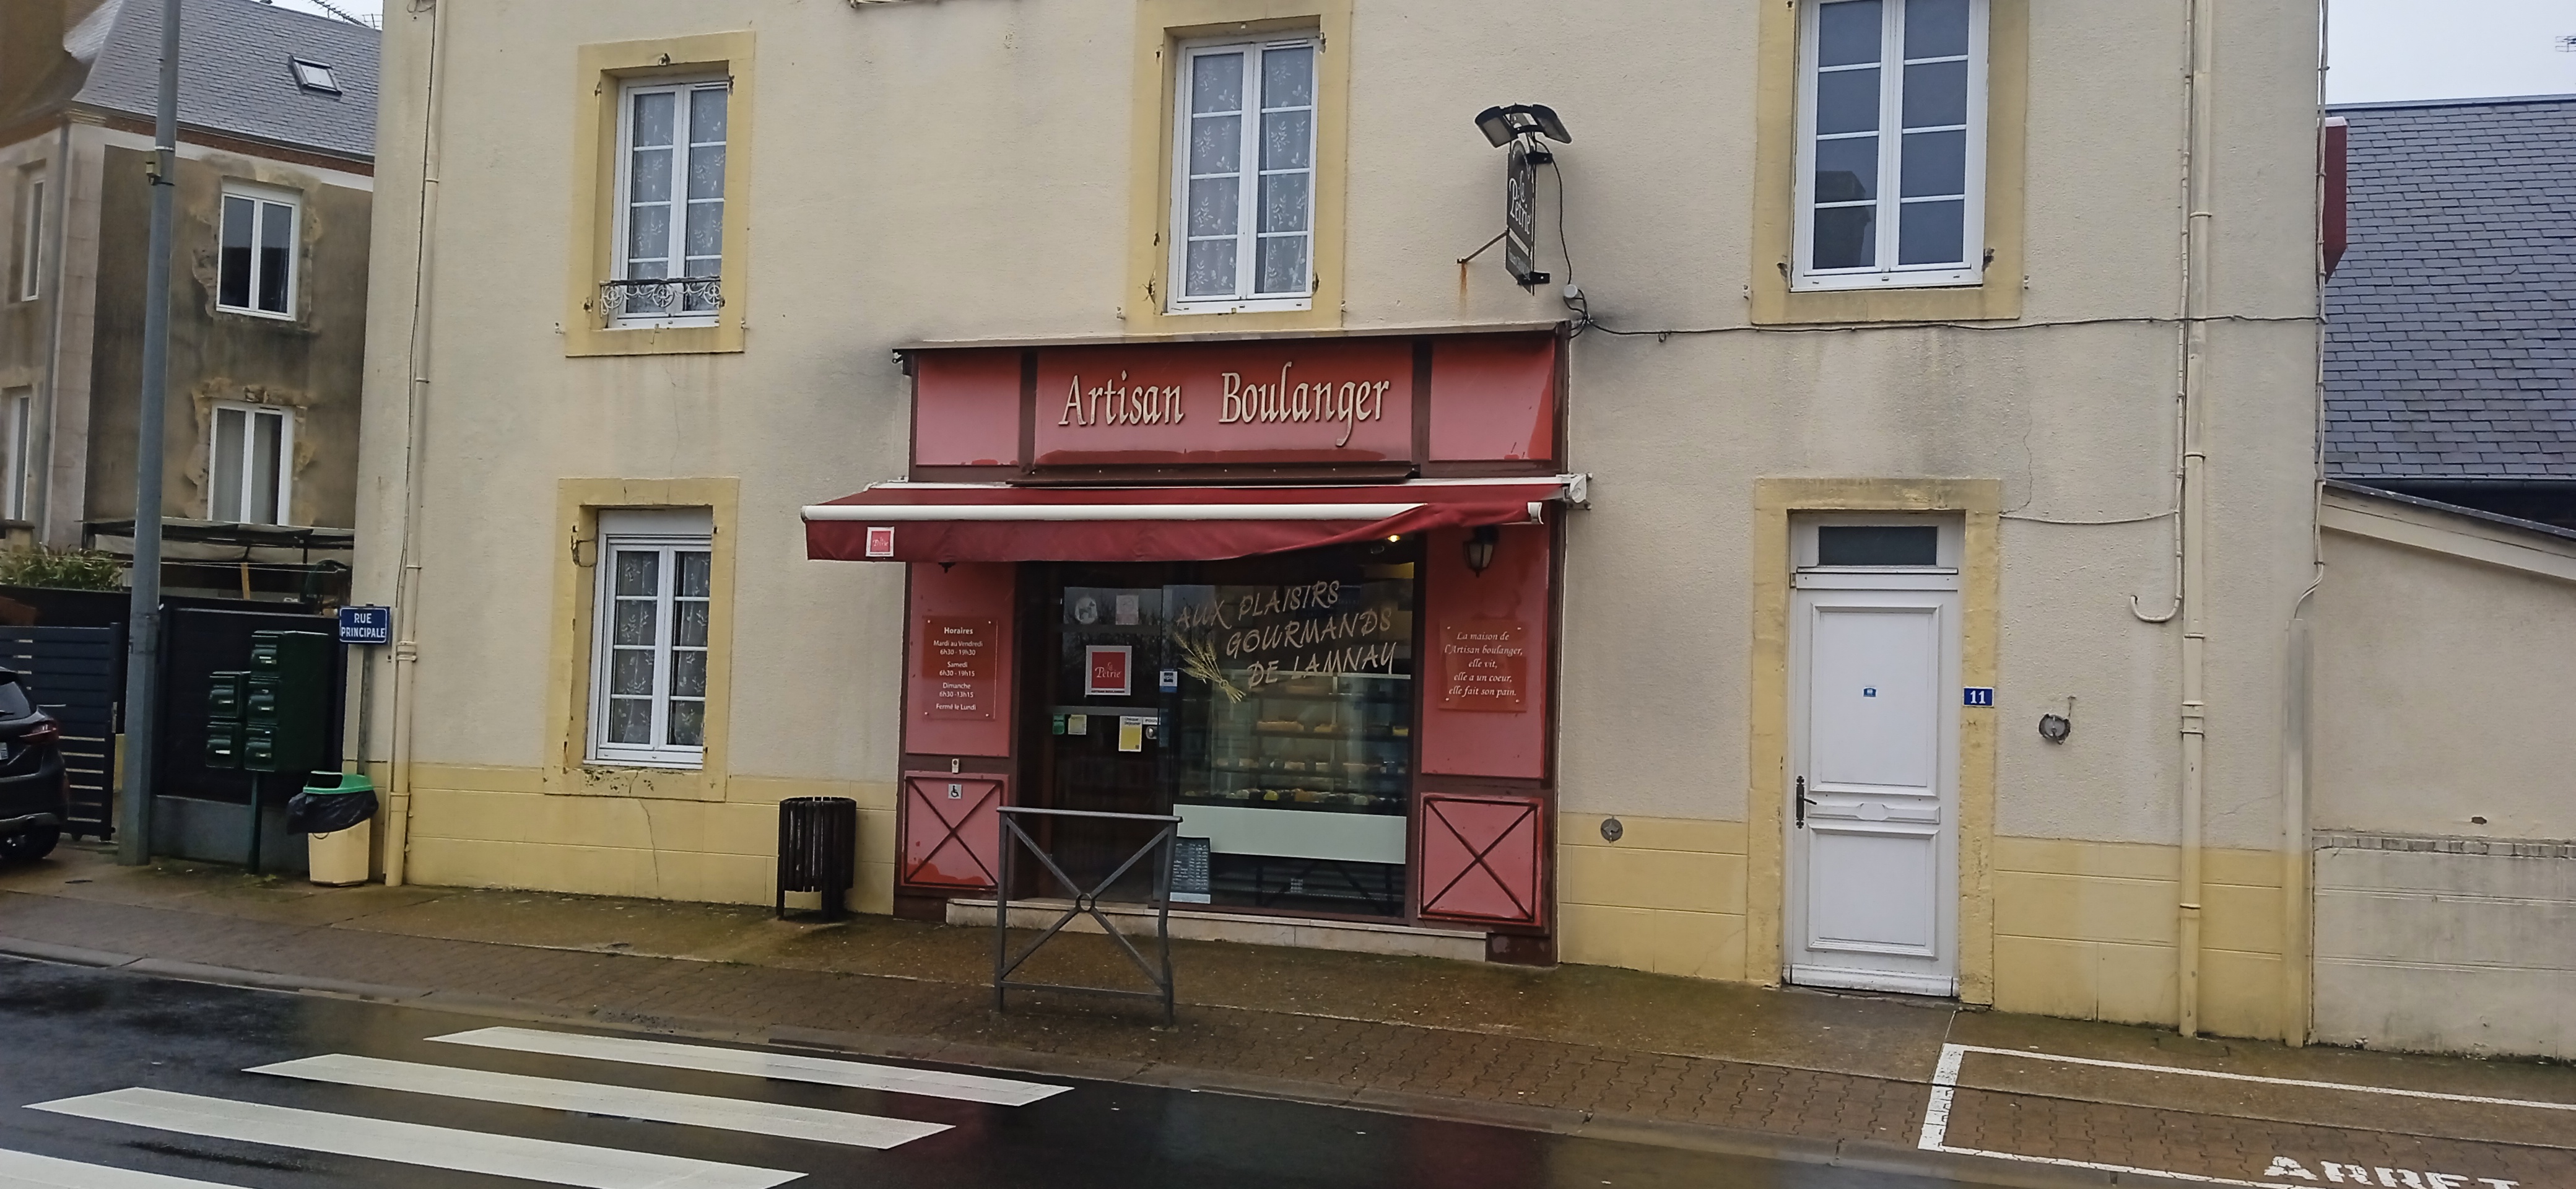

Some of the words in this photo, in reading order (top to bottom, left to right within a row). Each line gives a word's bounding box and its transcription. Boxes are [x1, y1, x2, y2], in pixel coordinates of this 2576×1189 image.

[1509, 178, 1531, 235] Pétrie
[1058, 370, 1185, 426] Artisan
[1219, 361, 1390, 446] Boulanger
[1177, 600, 1232, 629] AUX
[1238, 580, 1339, 621] PLAISIRS
[354, 613, 372, 624] RUE
[341, 627, 386, 638] PRINCIPALE
[1226, 608, 1391, 659] GOURMANDS
[1456, 632, 1468, 640] La
[1470, 632, 1498, 640] maison
[1500, 631, 1510, 640] de
[1445, 644, 1479, 655] l'Artisan
[1482, 645, 1523, 657] boulanger,
[1247, 660, 1279, 688] DE
[1291, 642, 1397, 680] LAMNAY
[1468, 658, 1482, 668] elle
[1484, 659, 1497, 669] vit,
[1454, 672, 1468, 681] elle
[1449, 685, 1463, 694] elle
[1461, 686, 1479, 697] fait
[1496, 688, 1516, 699] pain.
[1970, 690, 1986, 704] 11
